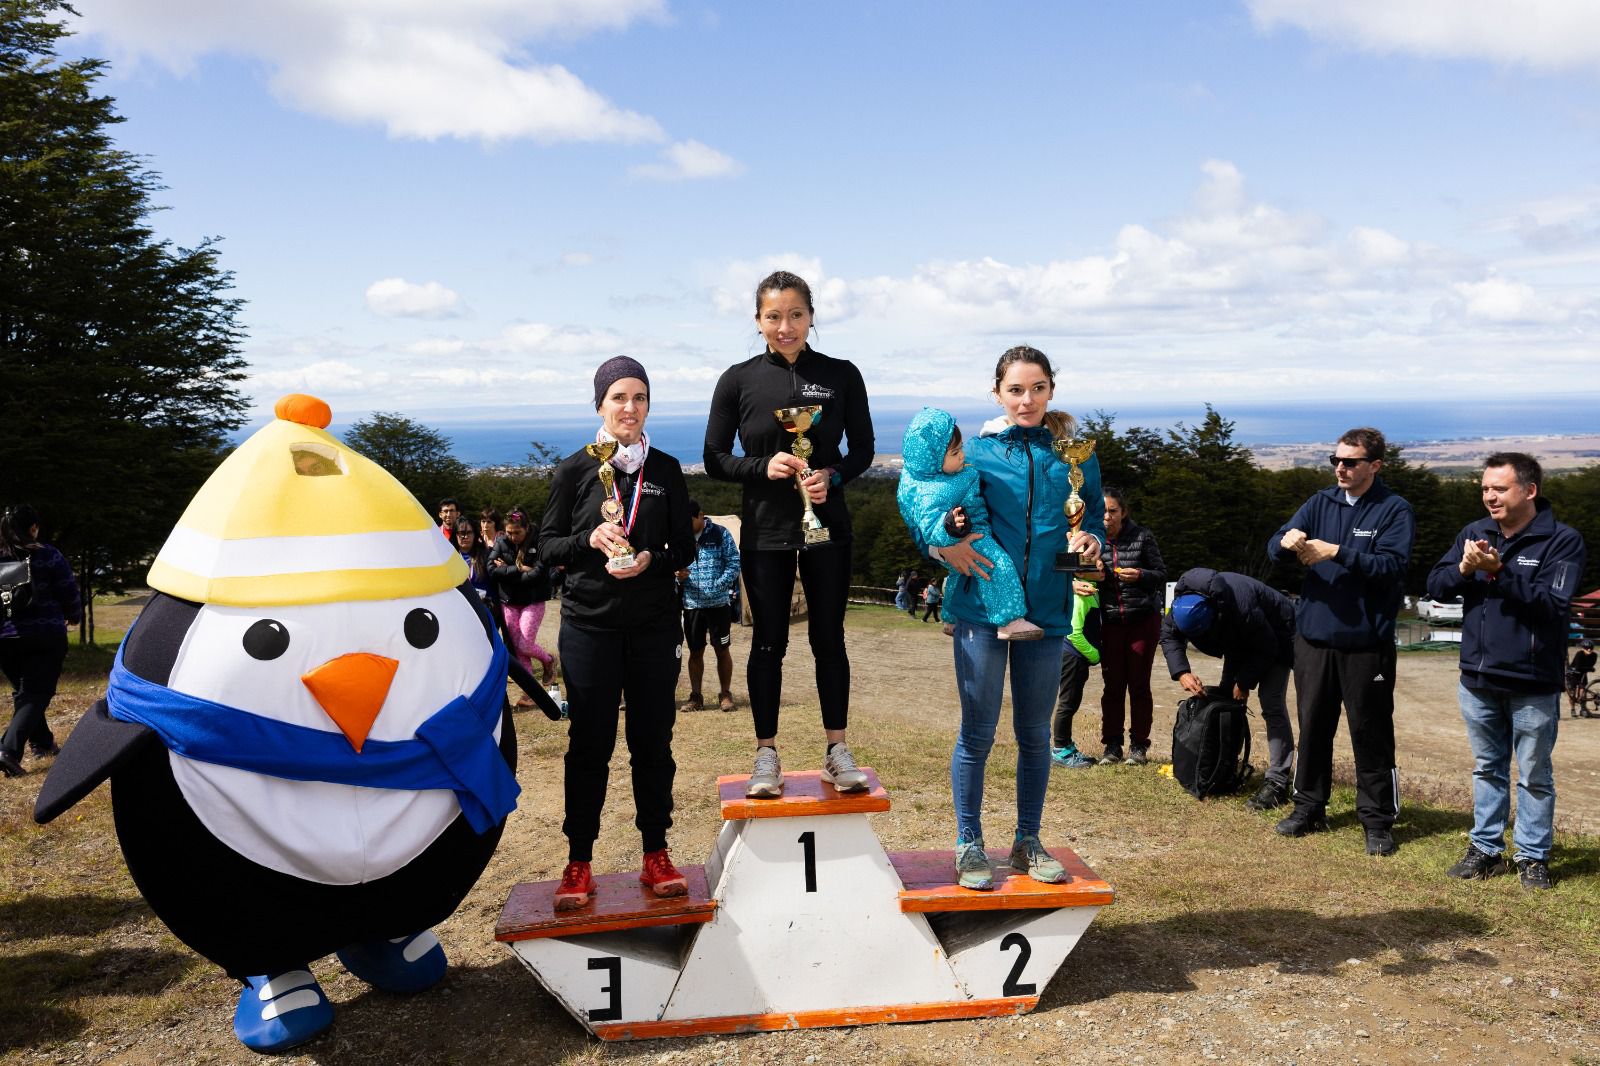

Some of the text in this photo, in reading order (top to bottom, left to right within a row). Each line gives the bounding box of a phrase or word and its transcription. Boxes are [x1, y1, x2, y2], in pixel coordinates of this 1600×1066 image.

[798, 831, 817, 893] 1
[587, 956, 622, 1022] 3
[1000, 932, 1037, 997] 2
